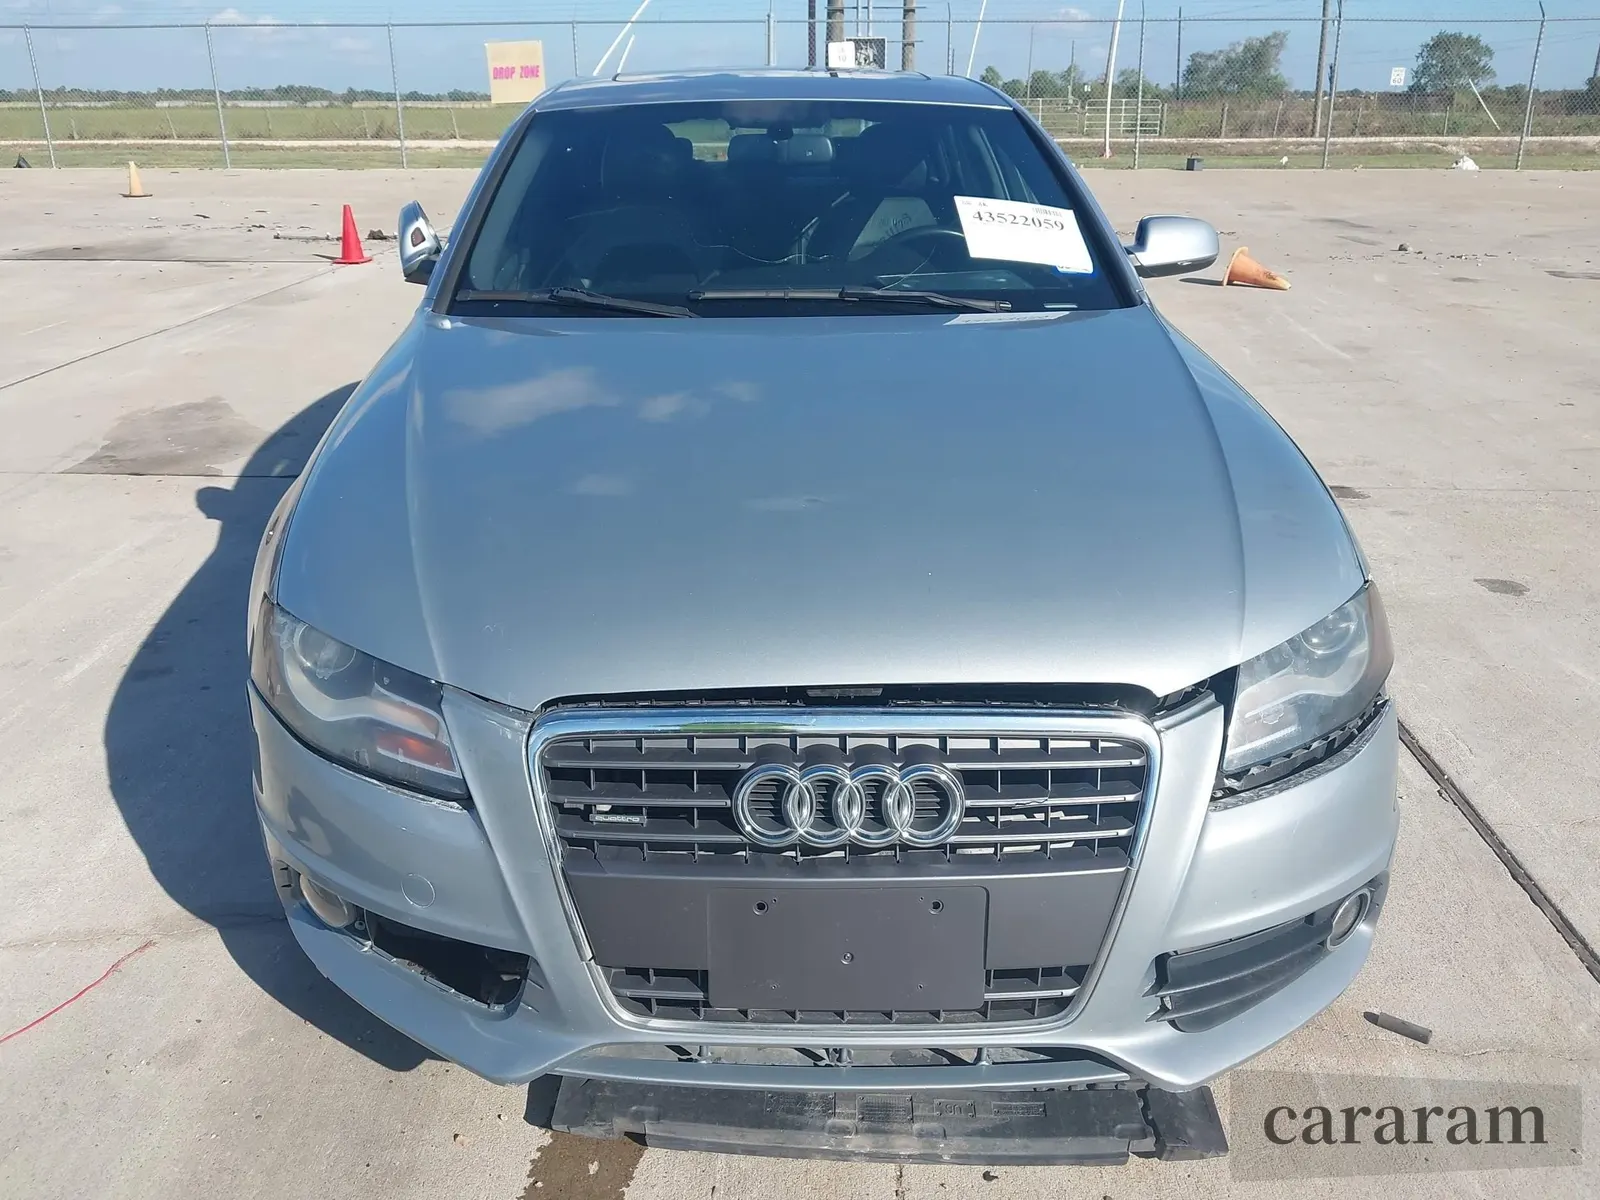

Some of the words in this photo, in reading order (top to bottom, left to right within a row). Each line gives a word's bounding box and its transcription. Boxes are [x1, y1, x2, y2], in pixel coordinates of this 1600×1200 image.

[493, 66, 516, 80] DROP
[520, 65, 540, 78] ZONE
[972, 210, 1065, 231] 43522059
[595, 814, 640, 822] quattro
